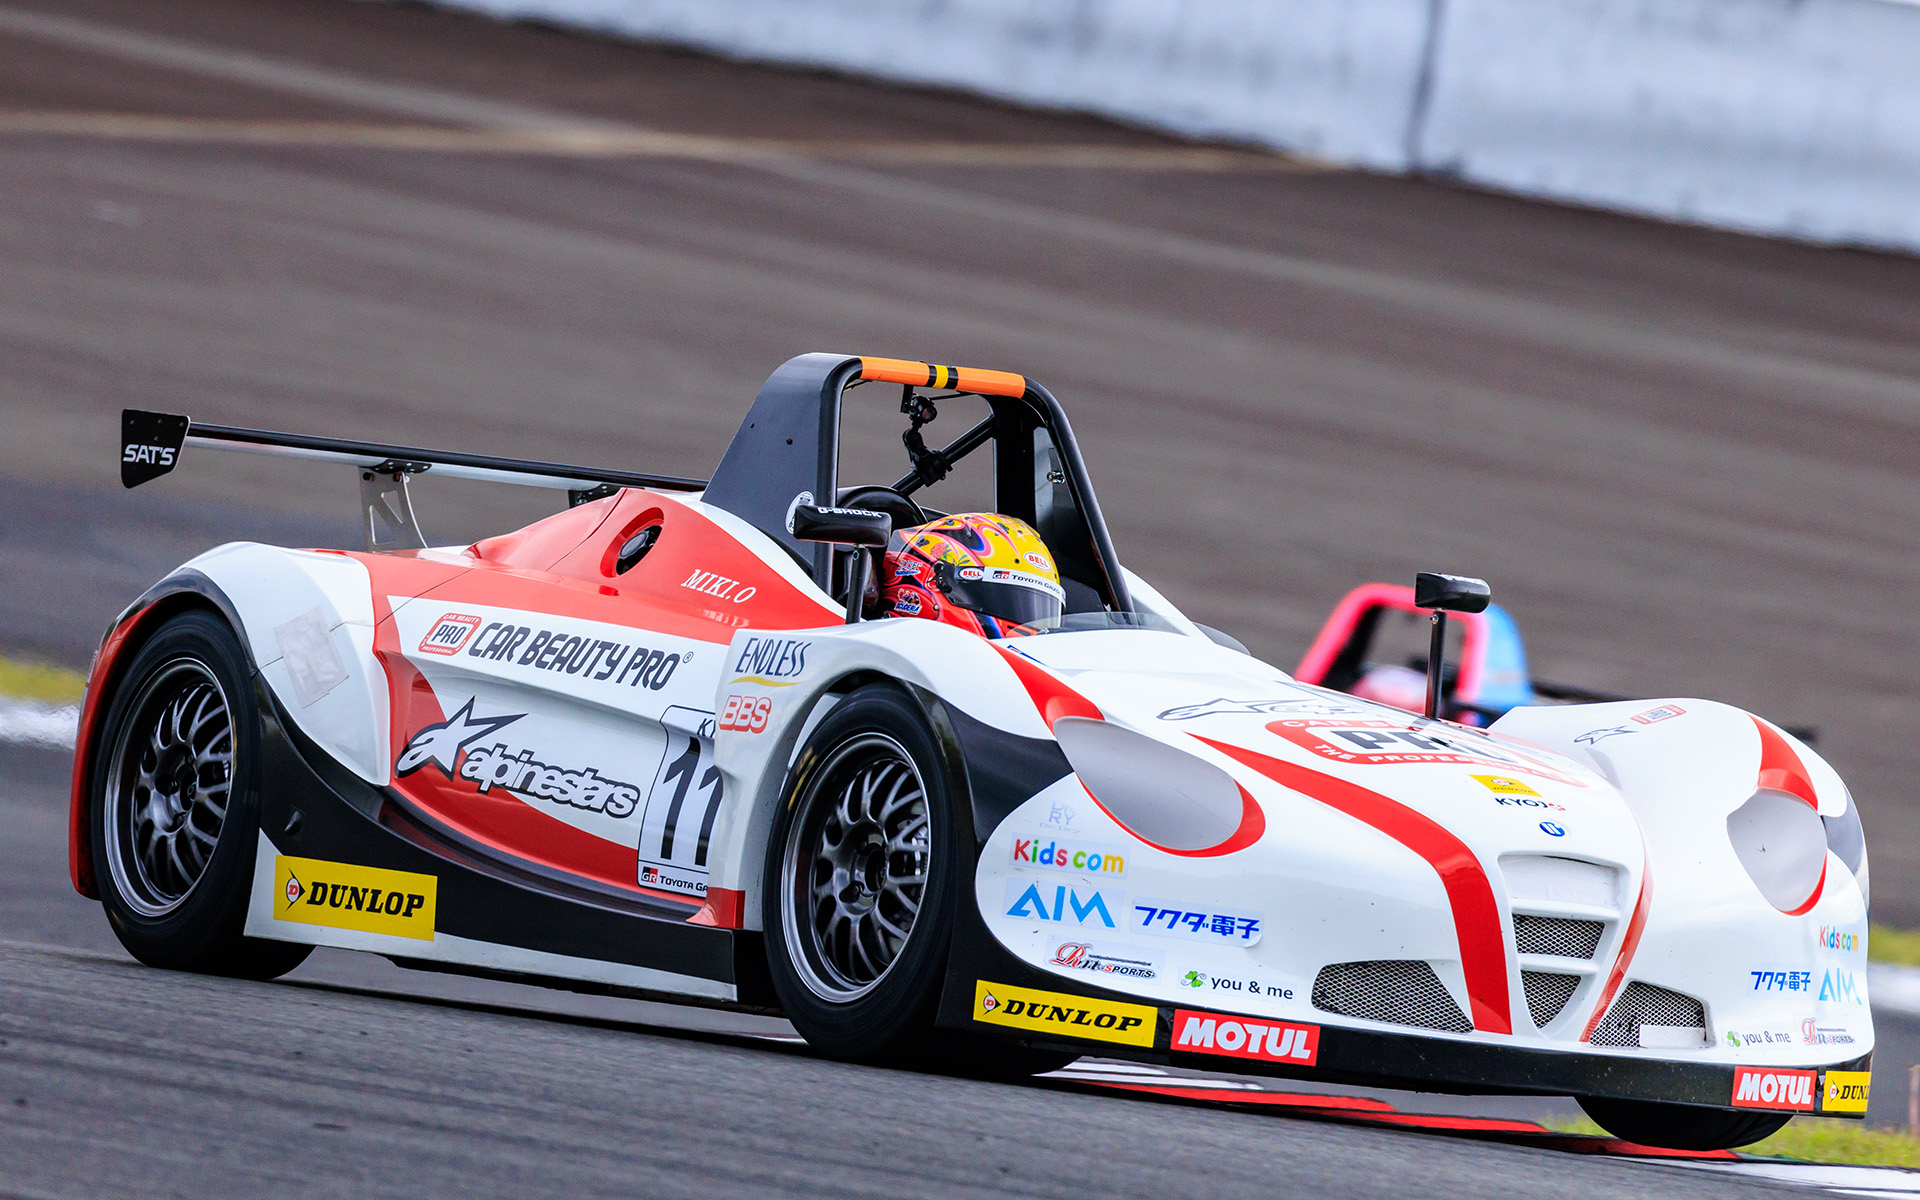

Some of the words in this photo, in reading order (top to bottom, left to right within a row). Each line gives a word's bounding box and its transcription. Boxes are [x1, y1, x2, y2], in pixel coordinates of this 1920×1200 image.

[122, 444, 176, 466] SAT'S
[1028, 554, 1049, 568] BELL
[680, 568, 757, 604] MIKI.O
[1011, 574, 1043, 586] TOYOTA
[431, 624, 467, 644] PRO
[468, 622, 531, 661] CAR
[517, 629, 623, 682] BEAUTY
[615, 648, 681, 691] PRO
[734, 637, 812, 678] ENDLESS
[719, 694, 772, 734] BBS
[1314, 744, 1357, 760] THE
[460, 742, 641, 819] alpinestars
[663, 736, 724, 867] 11
[1014, 838, 1068, 868] Kids
[1072, 849, 1124, 874] com
[641, 869, 658, 883] GR
[660, 875, 693, 890] TOYOTA
[306, 881, 425, 918] DUNLOP
[1006, 883, 1116, 928] AIM
[1135, 904, 1260, 940] フクダ電子
[1819, 925, 1840, 950] Kids
[1841, 933, 1859, 952] com
[1211, 975, 1242, 993] you
[1249, 980, 1262, 994] &
[1268, 984, 1294, 999] me
[1750, 971, 1811, 992] フクダ電子
[1818, 967, 1862, 1005] AIM
[1002, 999, 1143, 1032] DUNLOP
[1178, 1016, 1312, 1059] MOTUL
[1742, 1030, 1763, 1046] you
[1765, 1032, 1775, 1043] &
[1777, 1032, 1791, 1043] me
[1736, 1072, 1812, 1104] MOTUL
